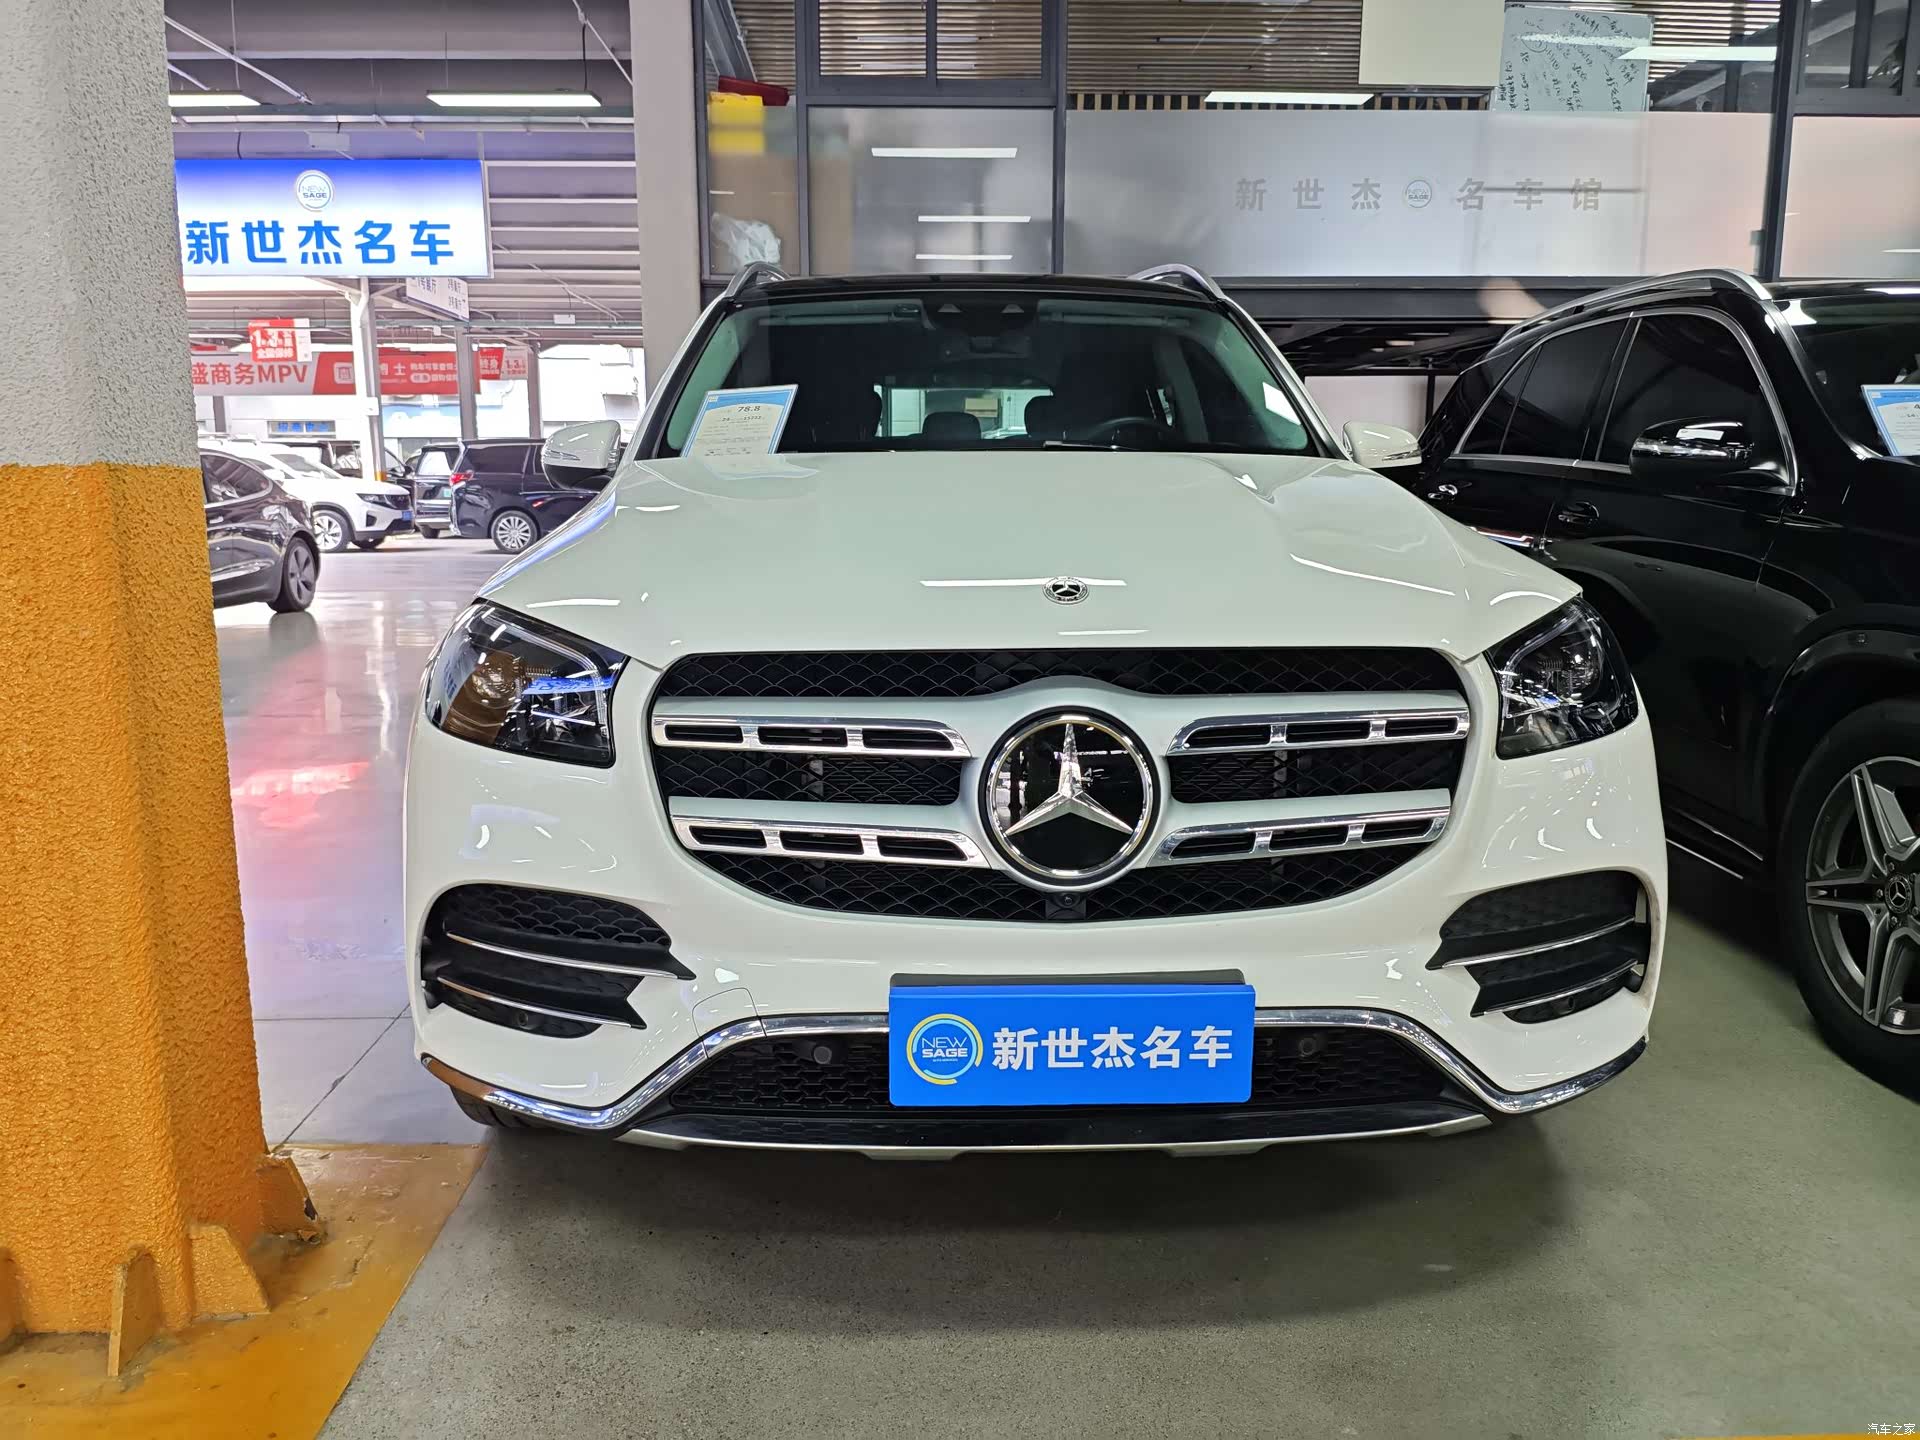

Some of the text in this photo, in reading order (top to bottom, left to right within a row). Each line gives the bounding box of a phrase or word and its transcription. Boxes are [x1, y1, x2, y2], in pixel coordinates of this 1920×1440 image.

[1235, 177, 1602, 211] 新世杰 名车馆
[186, 220, 454, 265] 新世杰名车
[921, 1036, 967, 1048] NEW
[922, 1048, 968, 1058] SAGE
[991, 1025, 1233, 1071] 新世杰名车
